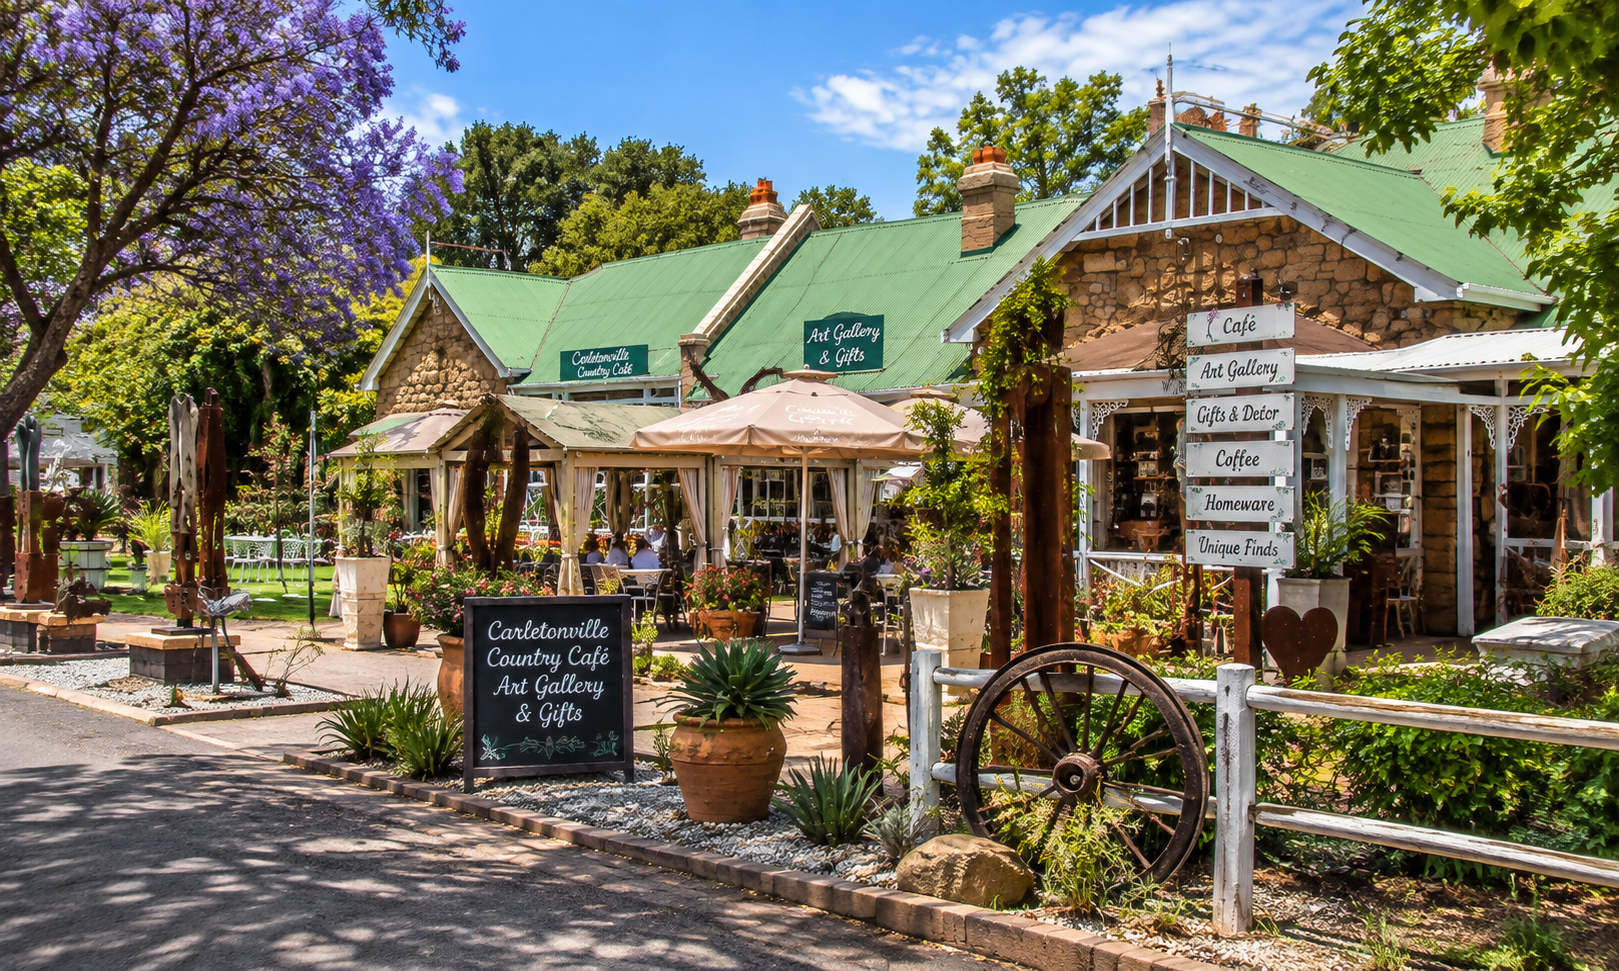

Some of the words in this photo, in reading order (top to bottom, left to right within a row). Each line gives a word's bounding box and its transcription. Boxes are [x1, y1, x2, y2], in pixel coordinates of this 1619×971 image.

[806, 327, 831, 344] Art
[833, 322, 880, 346] Gallery
[1223, 313, 1256, 337] Café
[819, 350, 830, 365] &
[835, 347, 865, 368] Gifts
[1200, 361, 1224, 379] Art
[1227, 358, 1279, 383] Gallery
[1197, 405, 1226, 428] Gifts
[1228, 406, 1239, 422] &
[1215, 449, 1260, 472] Coffee
[1204, 494, 1275, 512] Homeware
[1198, 536, 1240, 559] Unique
[1244, 538, 1279, 557] Finds
[487, 618, 610, 641] Carletonville
[487, 646, 562, 674] Country
[568, 645, 610, 672] Café
[493, 675, 529, 696] Art
[535, 673, 605, 701] Gallery
[515, 703, 532, 723] &
[539, 701, 583, 728] Gifts
